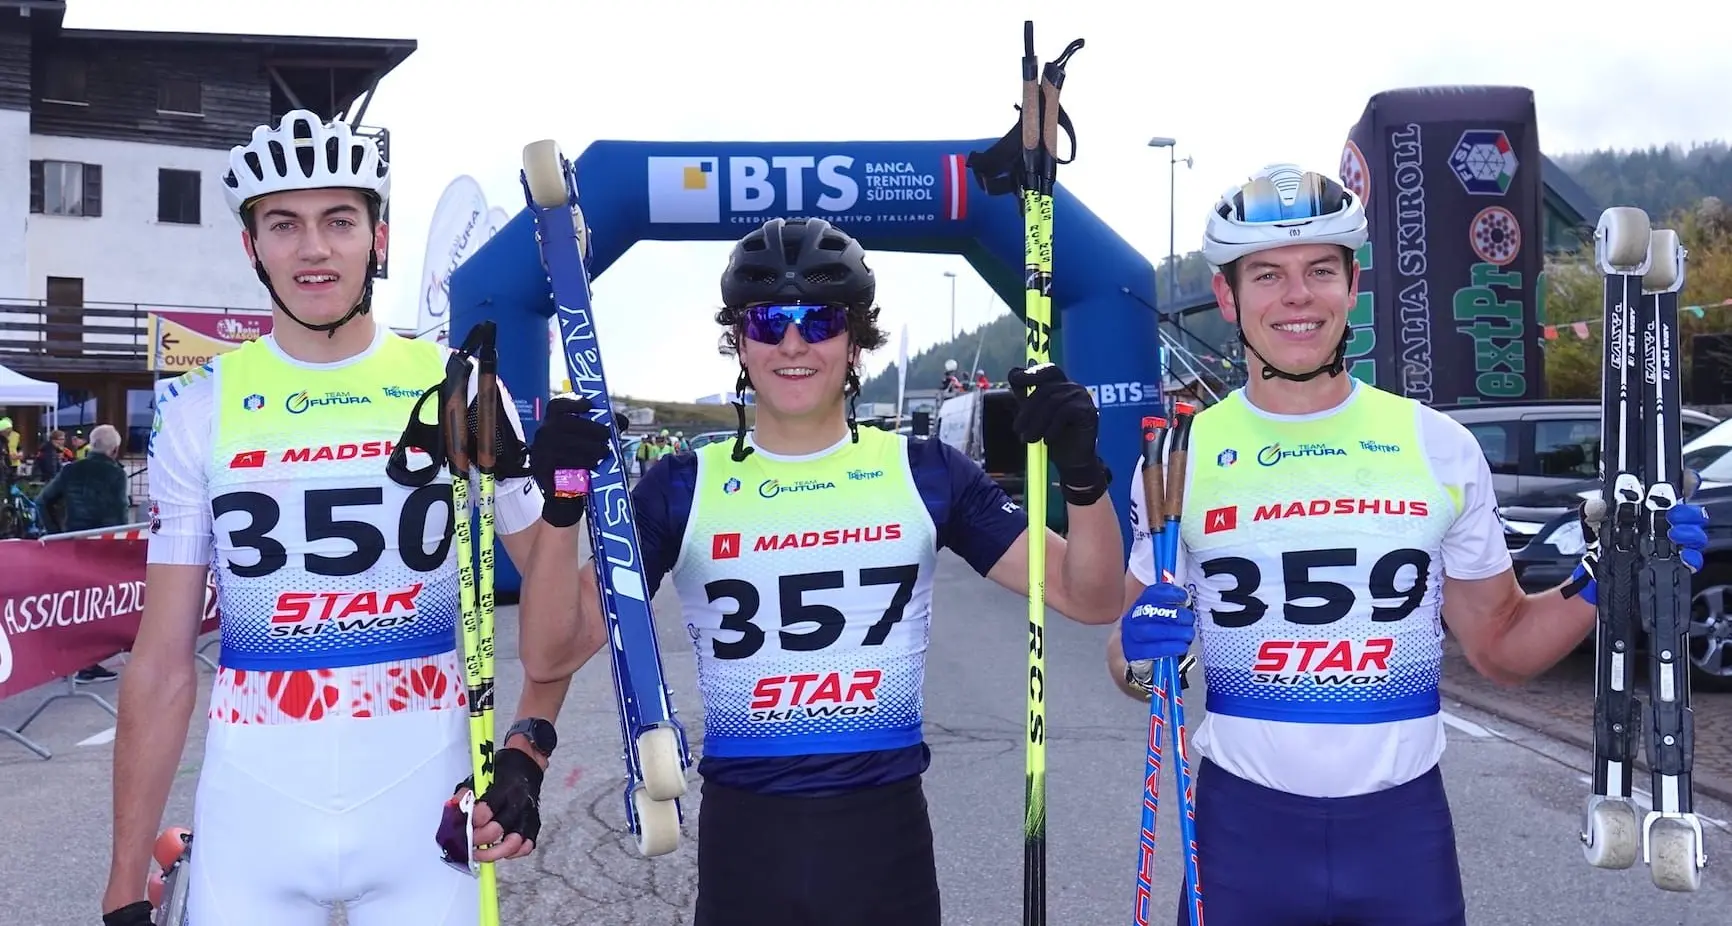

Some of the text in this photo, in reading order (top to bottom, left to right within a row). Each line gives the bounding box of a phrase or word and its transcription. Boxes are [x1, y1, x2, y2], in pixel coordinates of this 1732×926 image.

[865, 161, 914, 174] BANCA
[1455, 142, 1474, 182] FISI
[729, 154, 859, 212] BTS
[865, 174, 935, 187] TRENTINO
[866, 186, 933, 201] SÜDTIROL
[730, 215, 779, 224] CREDIT
[877, 213, 935, 223] ITALIANO
[1392, 123, 1434, 403] ITALIA SKIROLL
[1453, 261, 1527, 404] extPr
[310, 396, 371, 407] FUTURA
[1101, 382, 1143, 404] BTS
[1282, 448, 1347, 459] FUTURA
[780, 481, 836, 493] FUTURA
[1253, 498, 1429, 522] MADSHUS
[211, 483, 455, 579] 350
[753, 523, 901, 552] MADSHUS
[1200, 547, 1432, 628] 359
[271, 582, 424, 624] STAR
[704, 563, 920, 660] 357
[271, 613, 419, 638] Ski Wax
[1252, 638, 1394, 672] STAR
[750, 670, 882, 709] STAR
[1029, 620, 1044, 746] RCS
[1253, 673, 1389, 685] Ski Wax
[750, 704, 879, 723] Ski Wax
